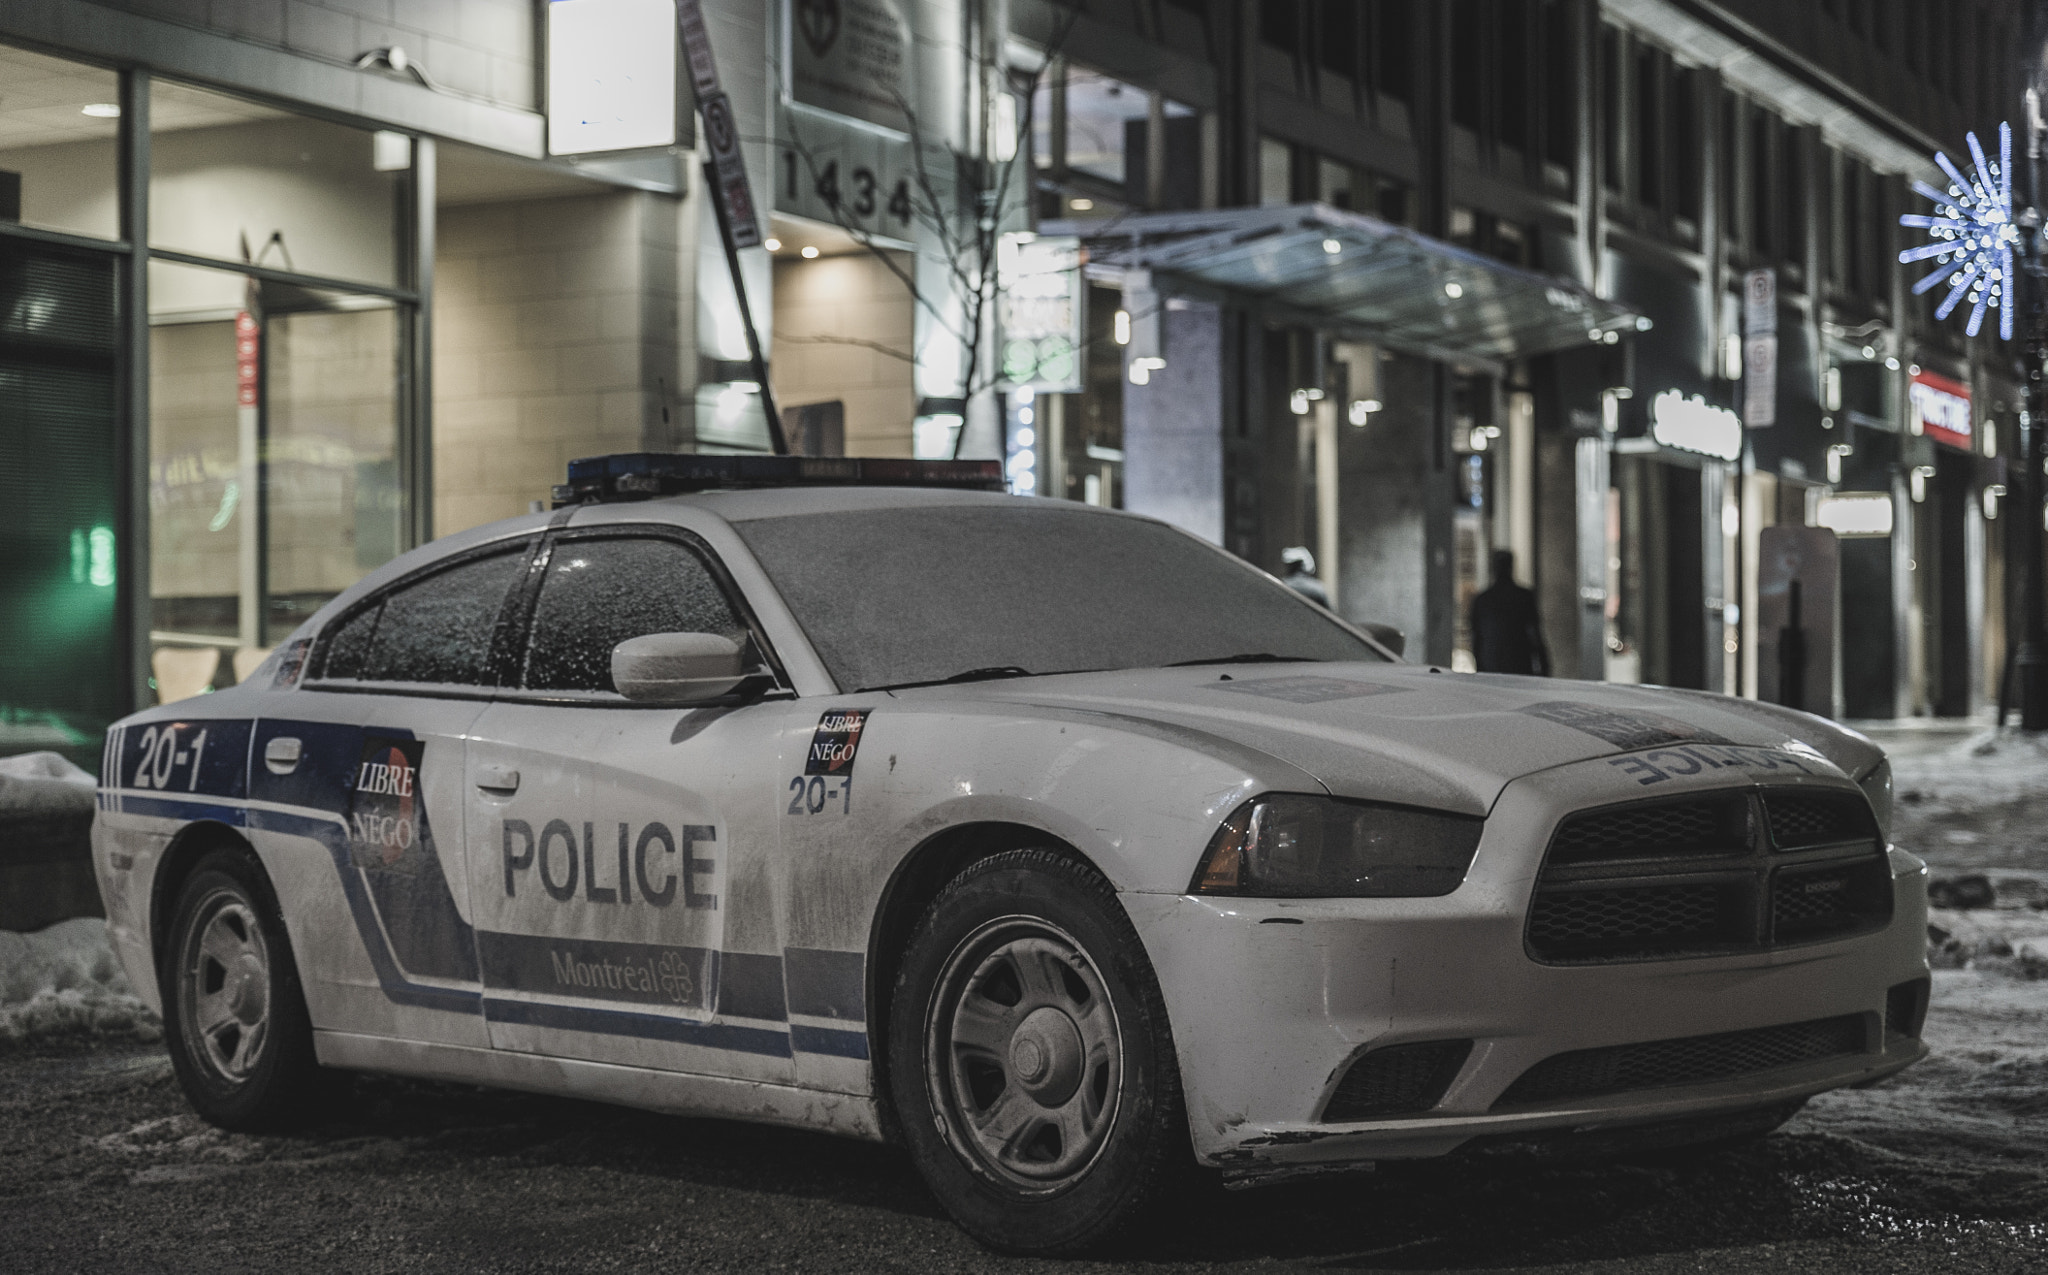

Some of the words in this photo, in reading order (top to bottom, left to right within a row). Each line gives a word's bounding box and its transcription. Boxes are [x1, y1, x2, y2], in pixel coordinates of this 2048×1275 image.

[784, 150, 912, 227] 1434
[818, 715, 865, 733] LIBRE
[133, 726, 208, 791] 20-1
[810, 738, 855, 761] NÉGO
[356, 762, 415, 797] LIBRE
[787, 775, 852, 815] 20-1
[353, 807, 412, 849] NÉGO
[503, 818, 718, 911] POLICE
[551, 951, 660, 992] Montréal
